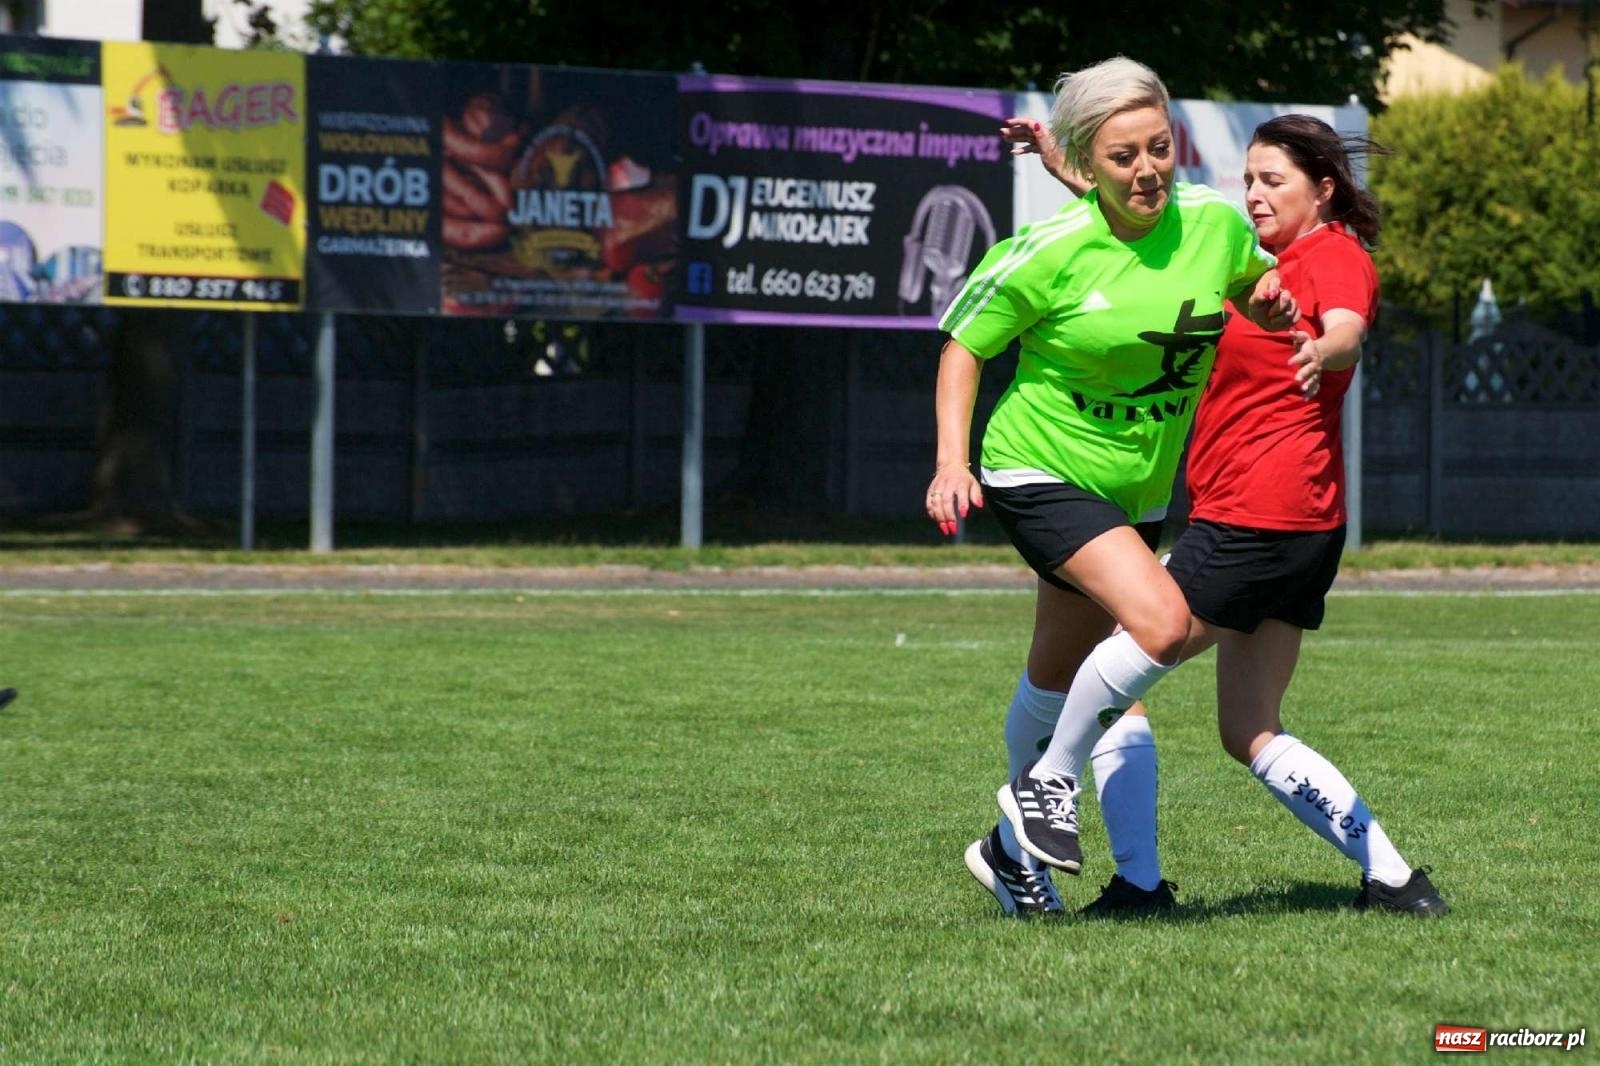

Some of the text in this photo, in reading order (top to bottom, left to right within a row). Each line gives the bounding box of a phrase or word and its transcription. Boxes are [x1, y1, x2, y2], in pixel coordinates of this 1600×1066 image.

[158, 83, 298, 132] BAGER
[690, 112, 999, 167] Oprawa muzyczna imprez
[319, 157, 429, 206] DRÓB
[319, 206, 429, 234] WĘDLINY
[507, 189, 613, 228] JANETA
[687, 173, 876, 248] DJ EUGENIUSZ
[749, 212, 869, 246] MIKOŁAJEK
[137, 243, 271, 264] TRANSPORTOWE
[195, 278, 237, 299] 557
[727, 264, 875, 301] tel. 660 623 761
